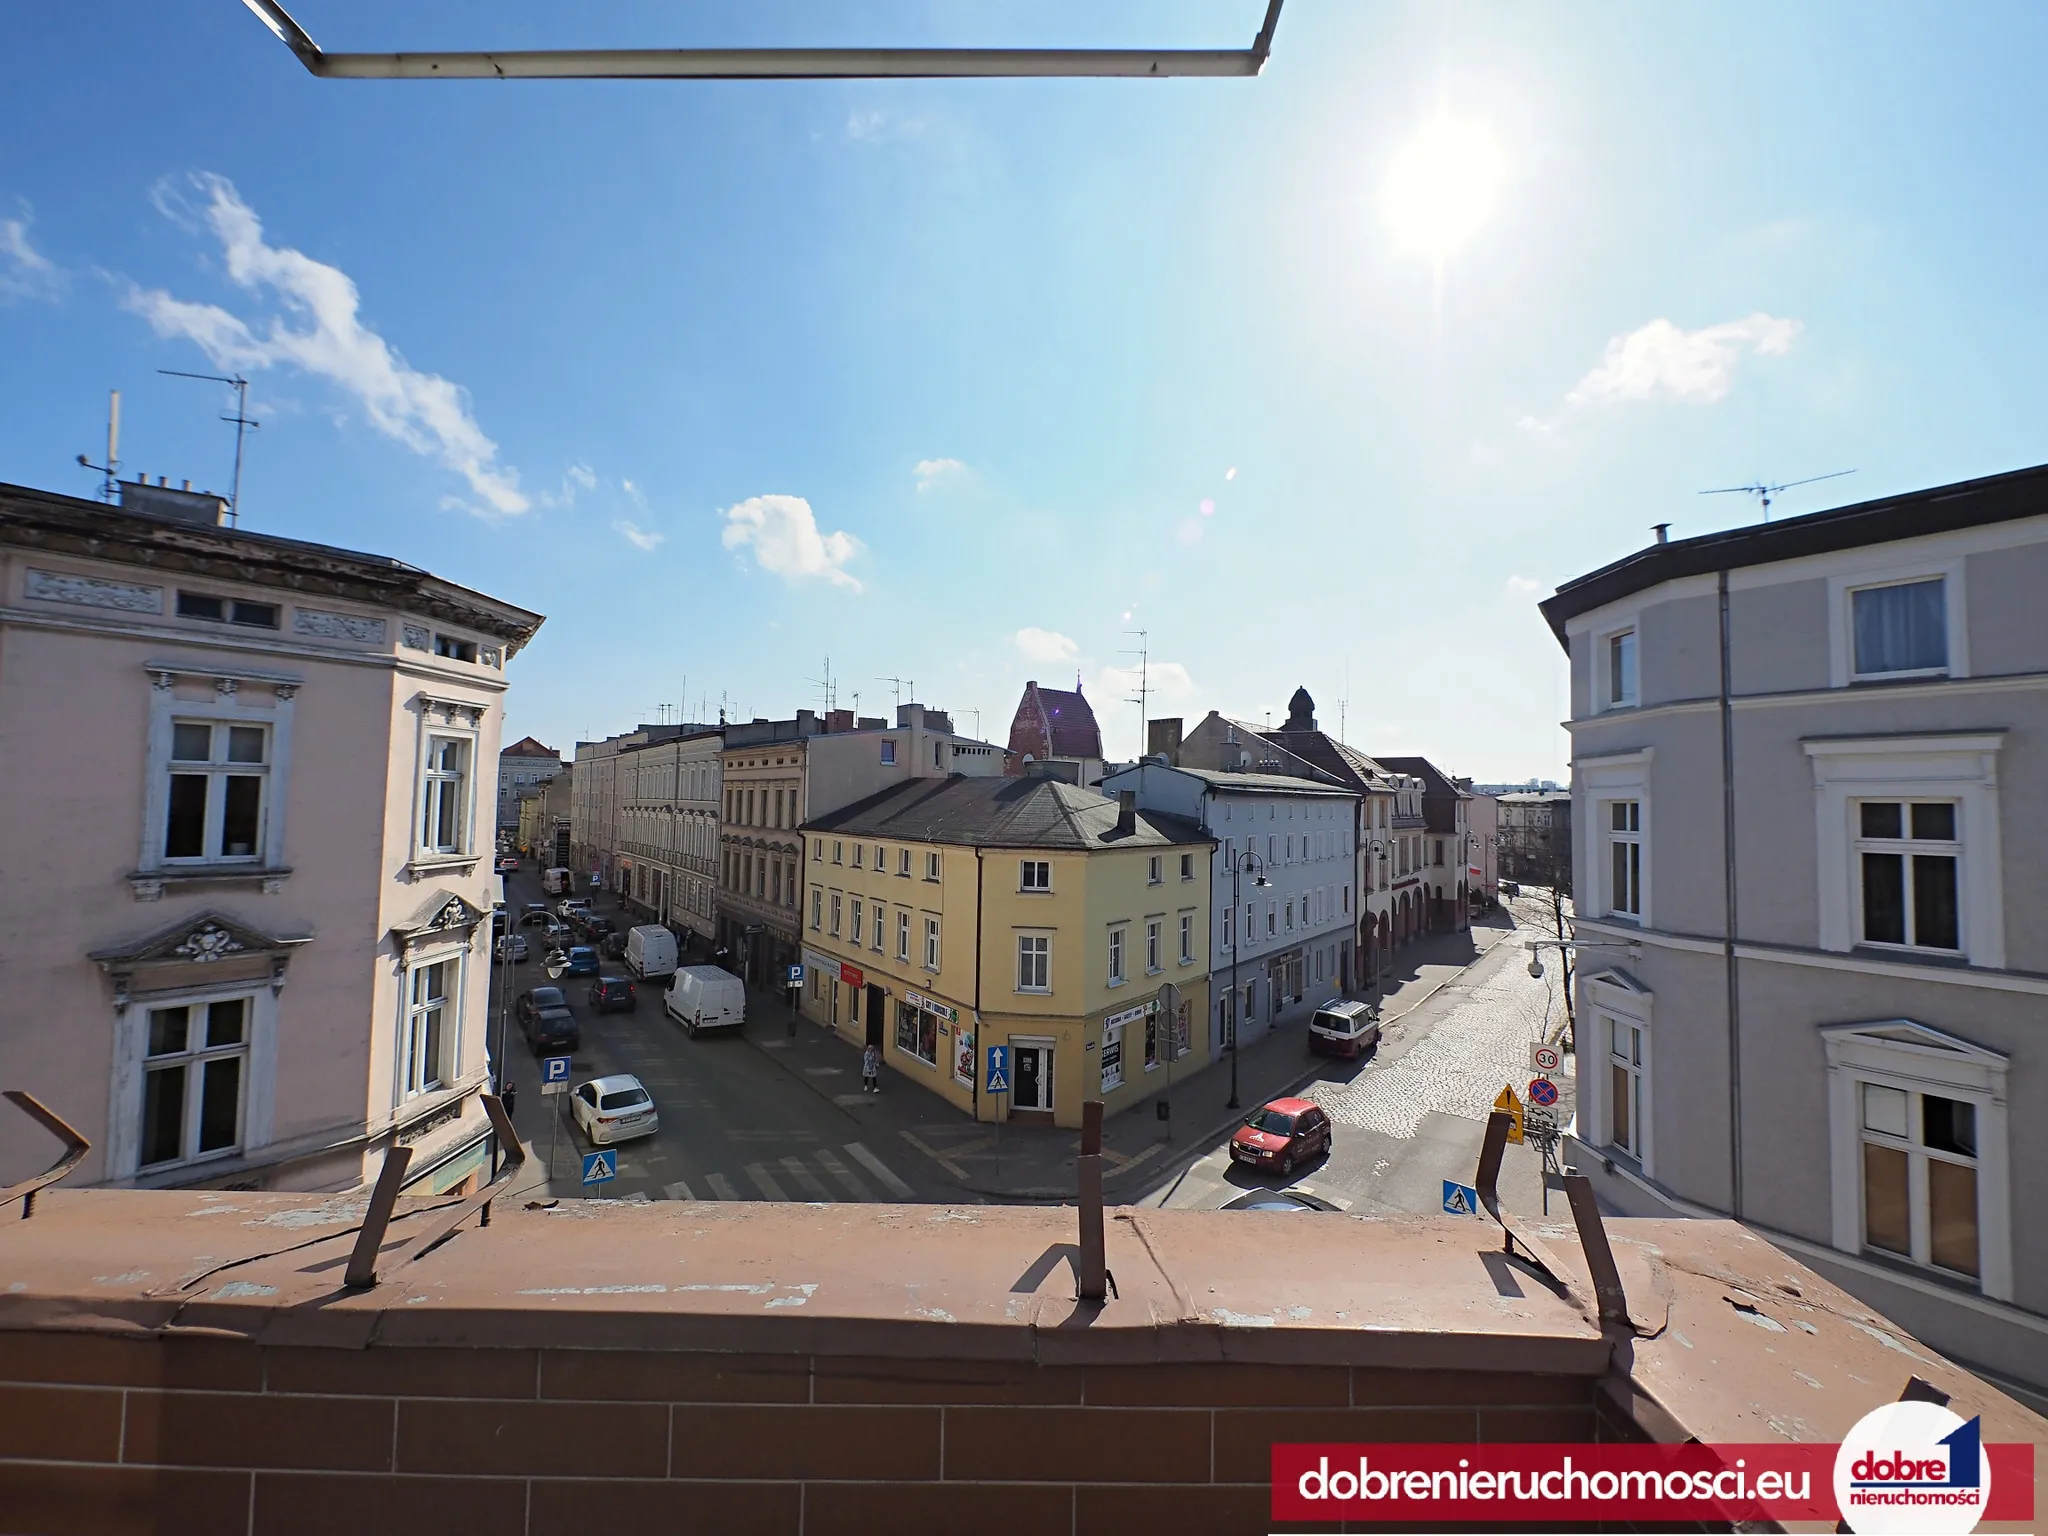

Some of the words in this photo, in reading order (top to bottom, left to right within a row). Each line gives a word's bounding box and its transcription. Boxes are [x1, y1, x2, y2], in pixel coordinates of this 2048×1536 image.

[791, 966, 801, 979] P
[1539, 1053, 1555, 1064] 30
[549, 1060, 565, 1080] P
